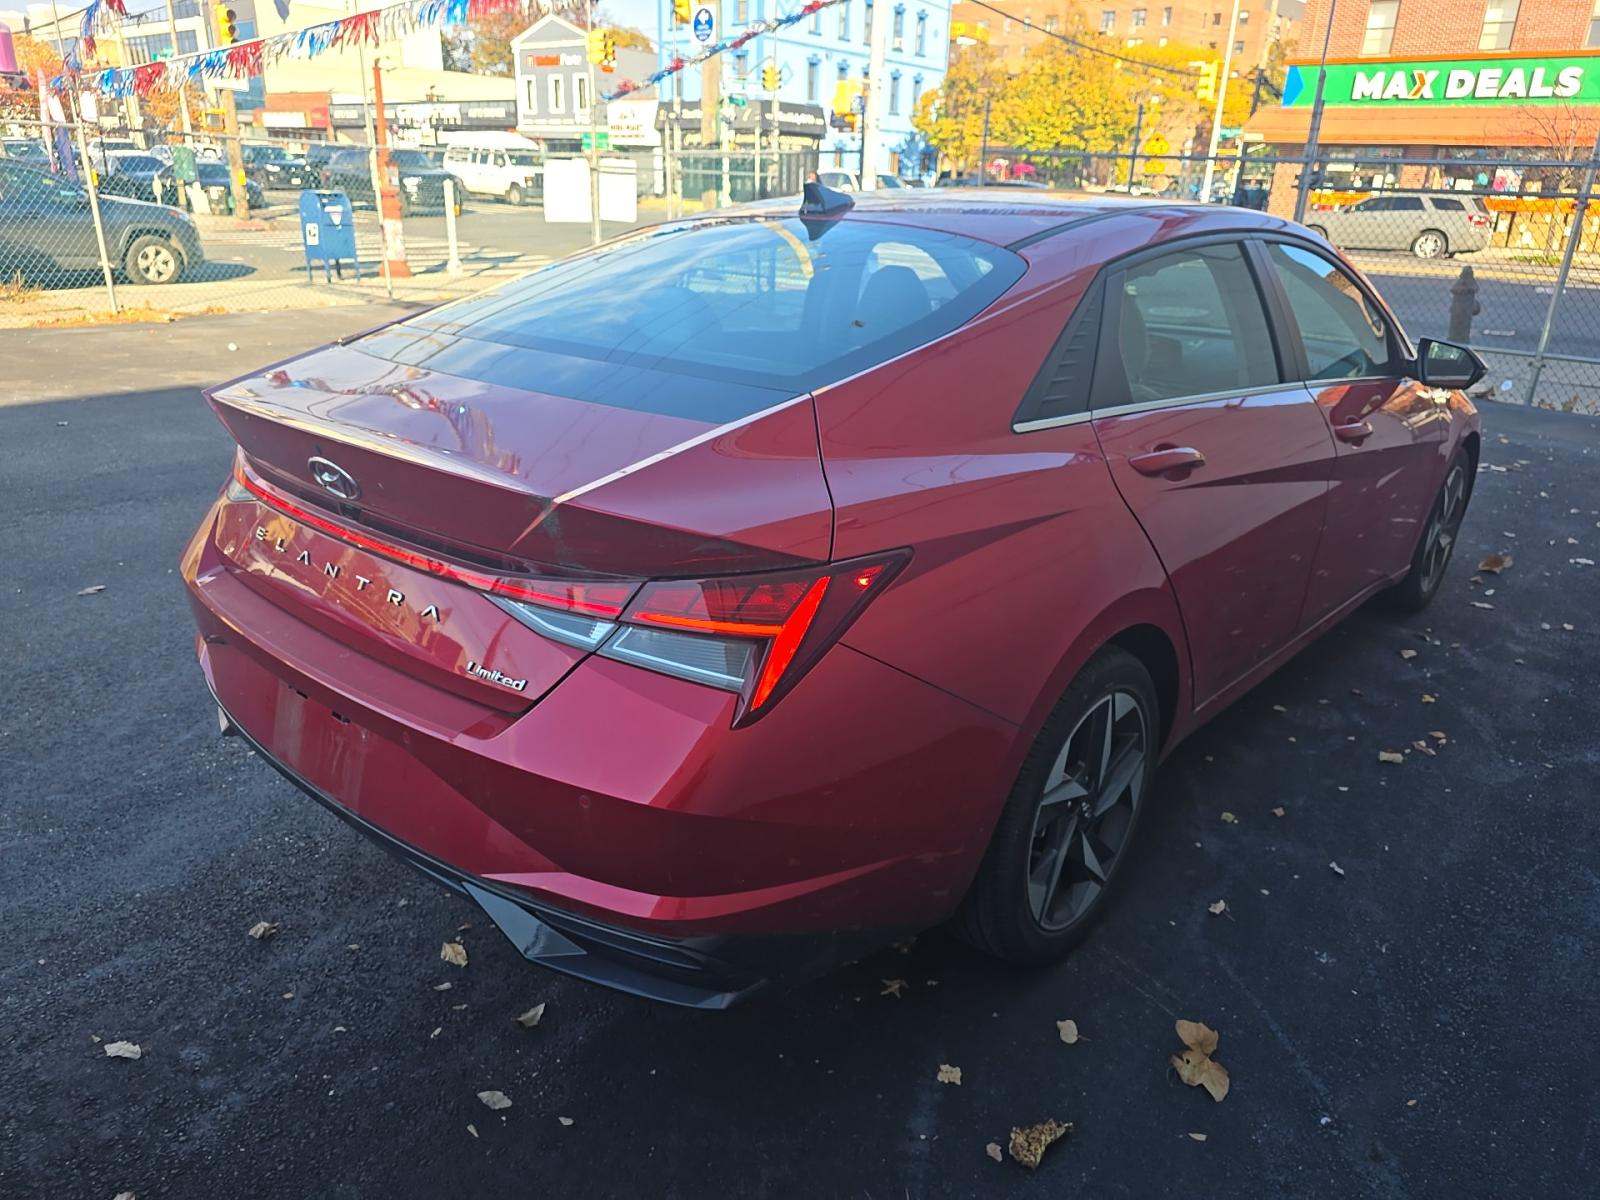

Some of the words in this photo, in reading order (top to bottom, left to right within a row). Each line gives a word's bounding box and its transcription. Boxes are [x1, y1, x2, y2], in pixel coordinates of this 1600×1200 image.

[1351, 70, 1439, 100] MAX
[1445, 67, 1584, 99] DEALS
[255, 526, 441, 622] ELANTRA
[466, 661, 526, 691] Limited
